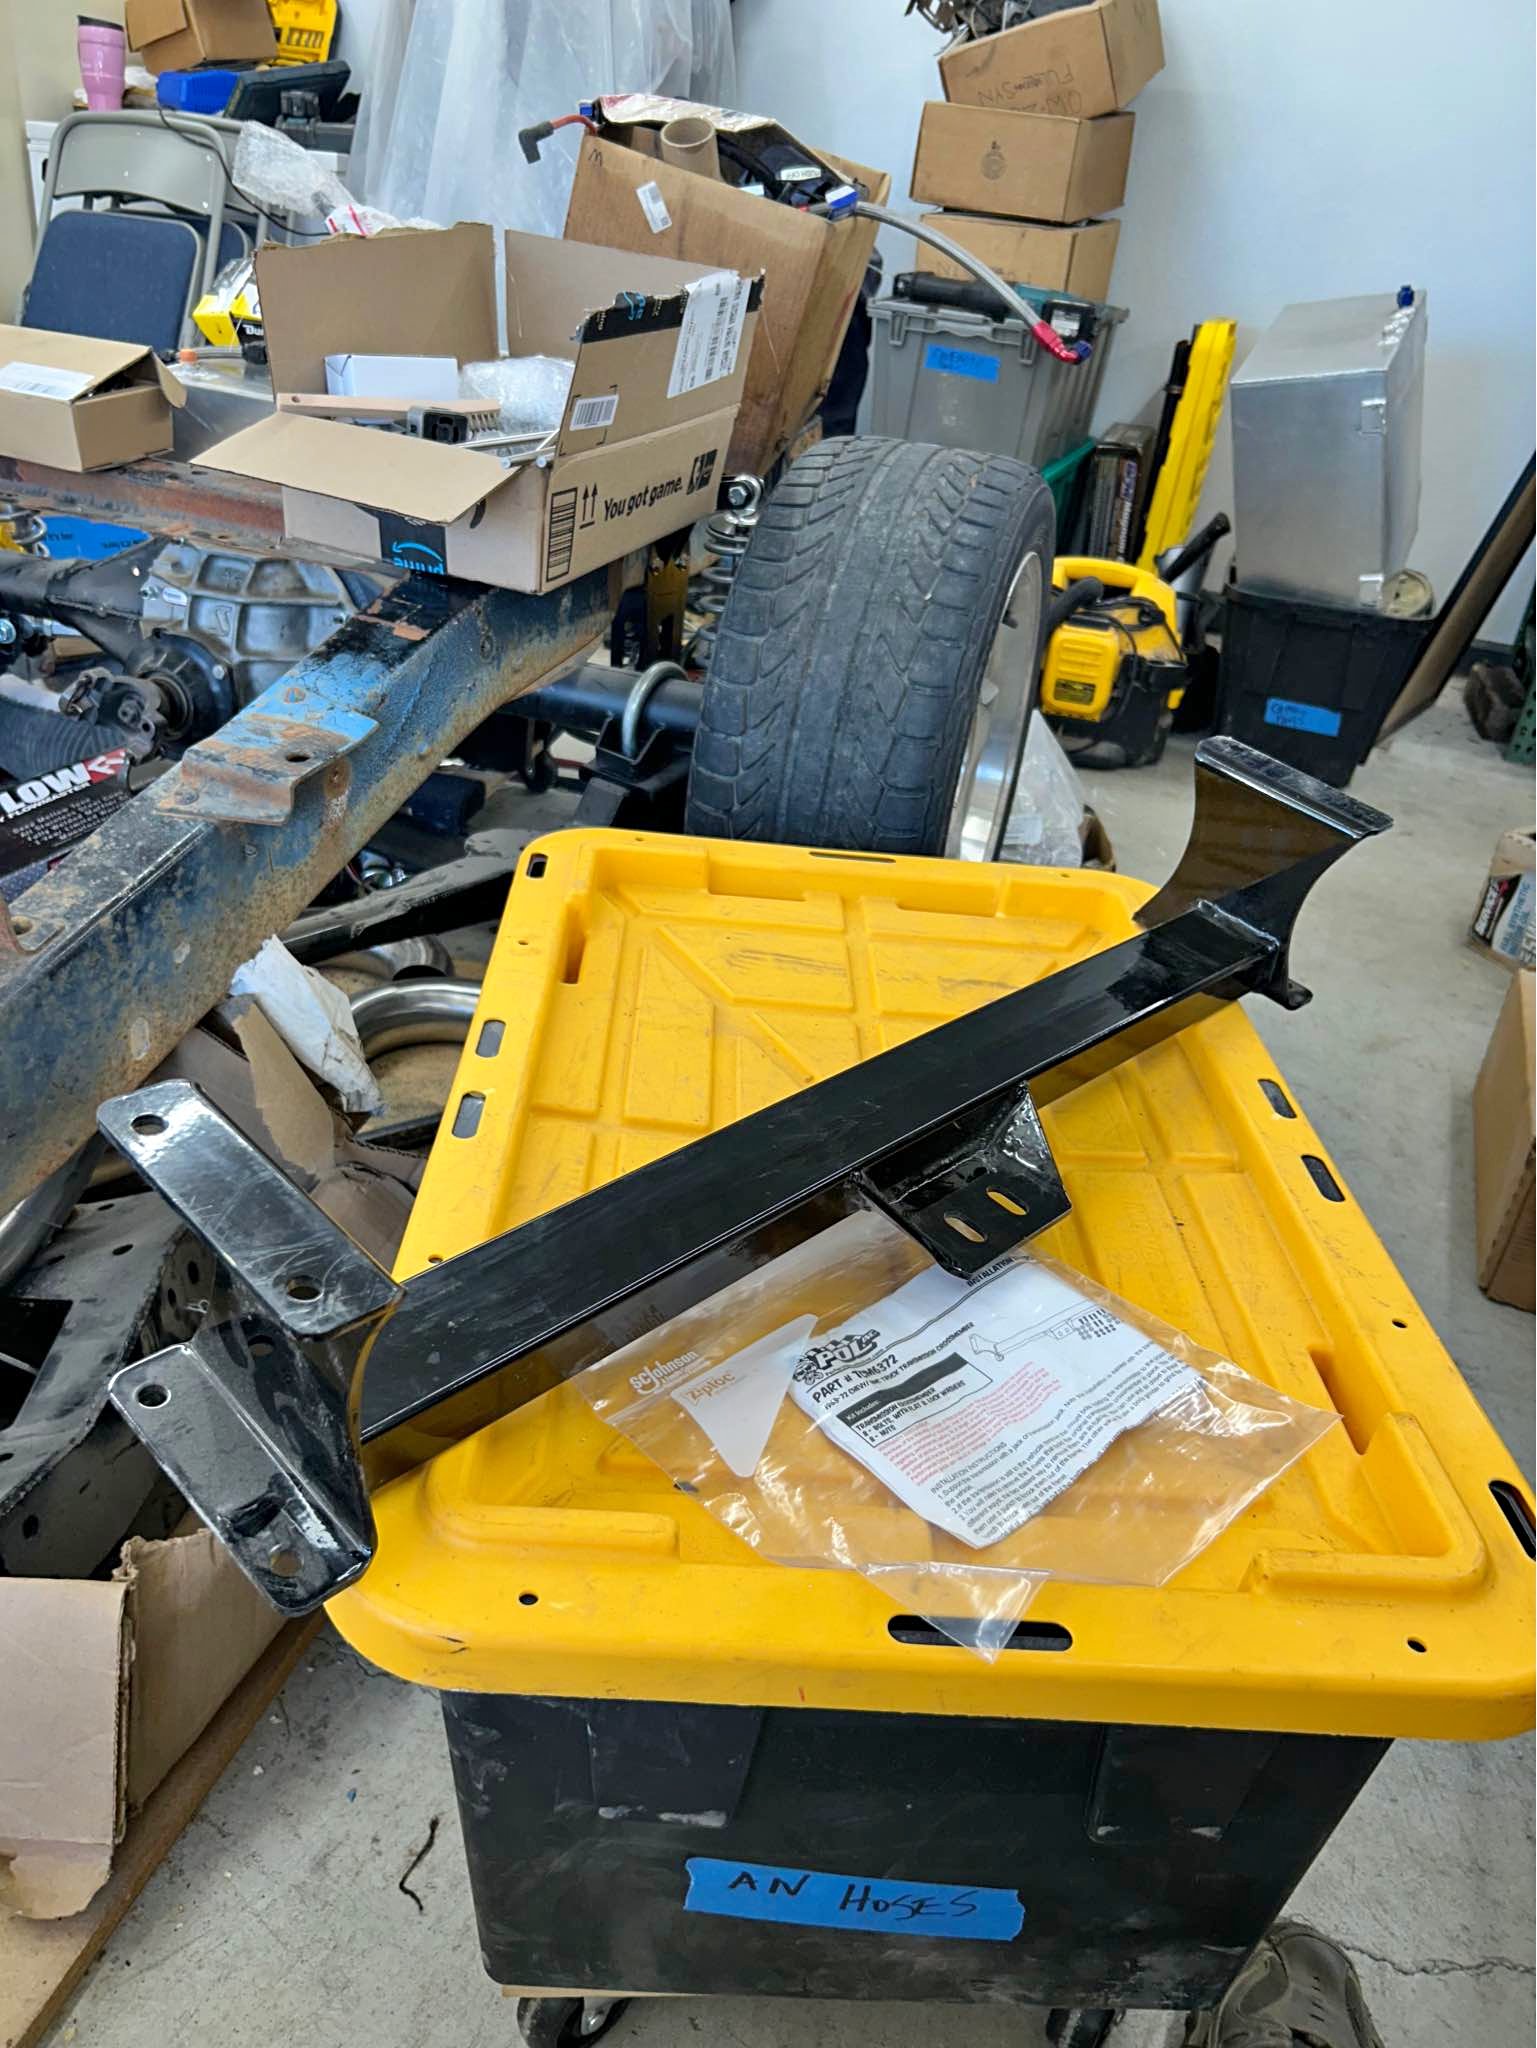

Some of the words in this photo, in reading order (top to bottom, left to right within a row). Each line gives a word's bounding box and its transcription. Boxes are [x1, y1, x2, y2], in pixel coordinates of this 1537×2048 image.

[604, 495, 627, 521] You
[626, 486, 649, 516] got
[649, 476, 683, 507] game.
[811, 1377, 843, 1404] PART
[844, 1373, 853, 1383] #
[853, 1352, 899, 1380] TCM6372
[727, 1871, 811, 1897] AN
